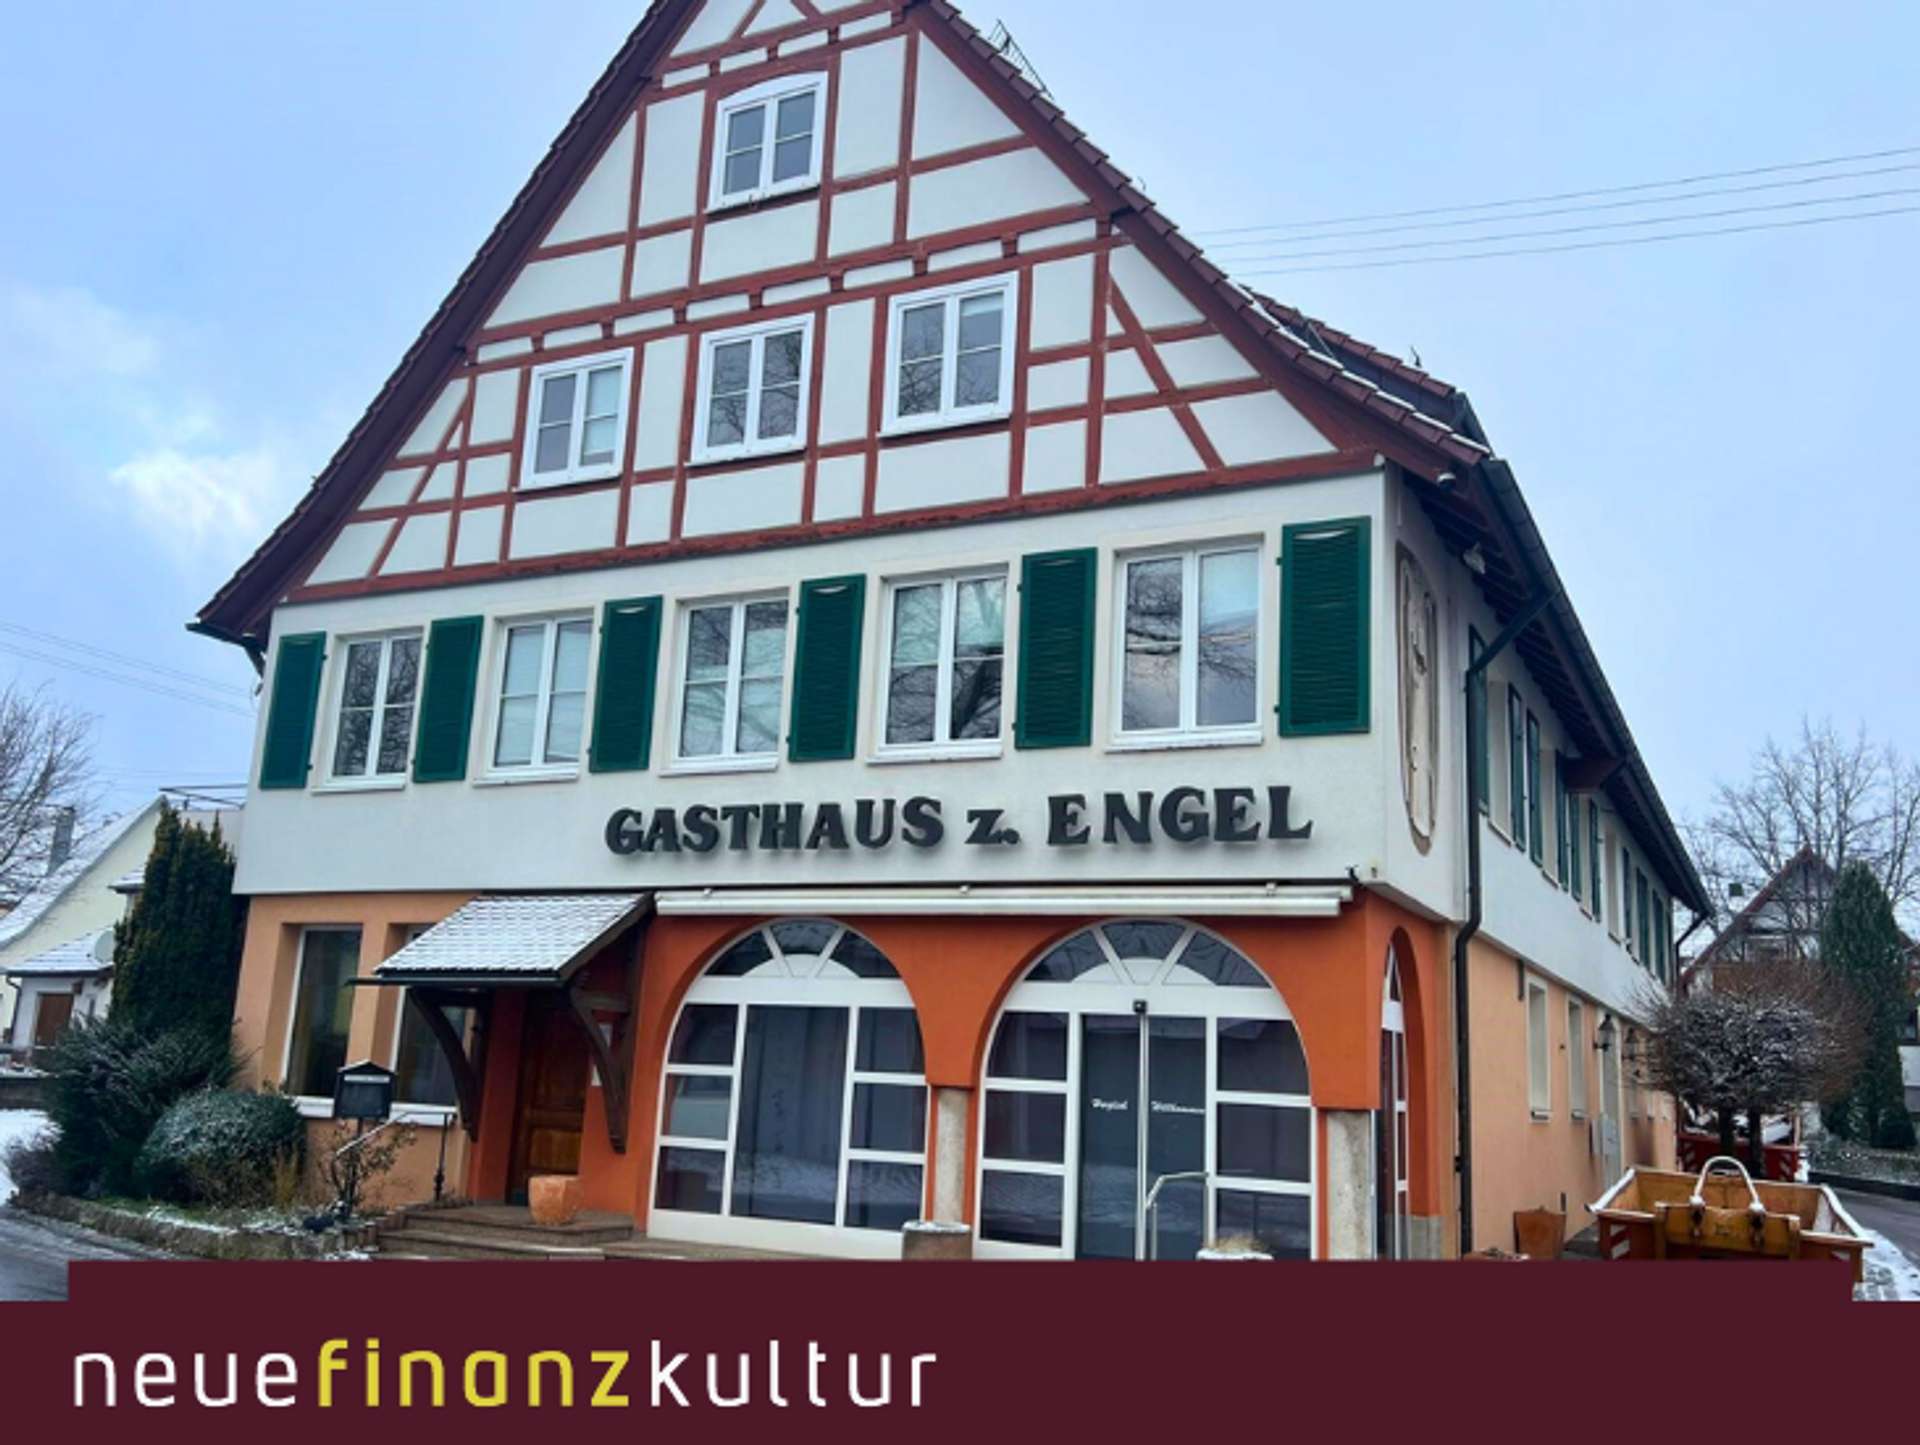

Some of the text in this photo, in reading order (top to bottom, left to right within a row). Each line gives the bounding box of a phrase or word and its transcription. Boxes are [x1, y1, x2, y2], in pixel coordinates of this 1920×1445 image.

[605, 786, 1312, 855] GASTHAUS z. ENGEL
